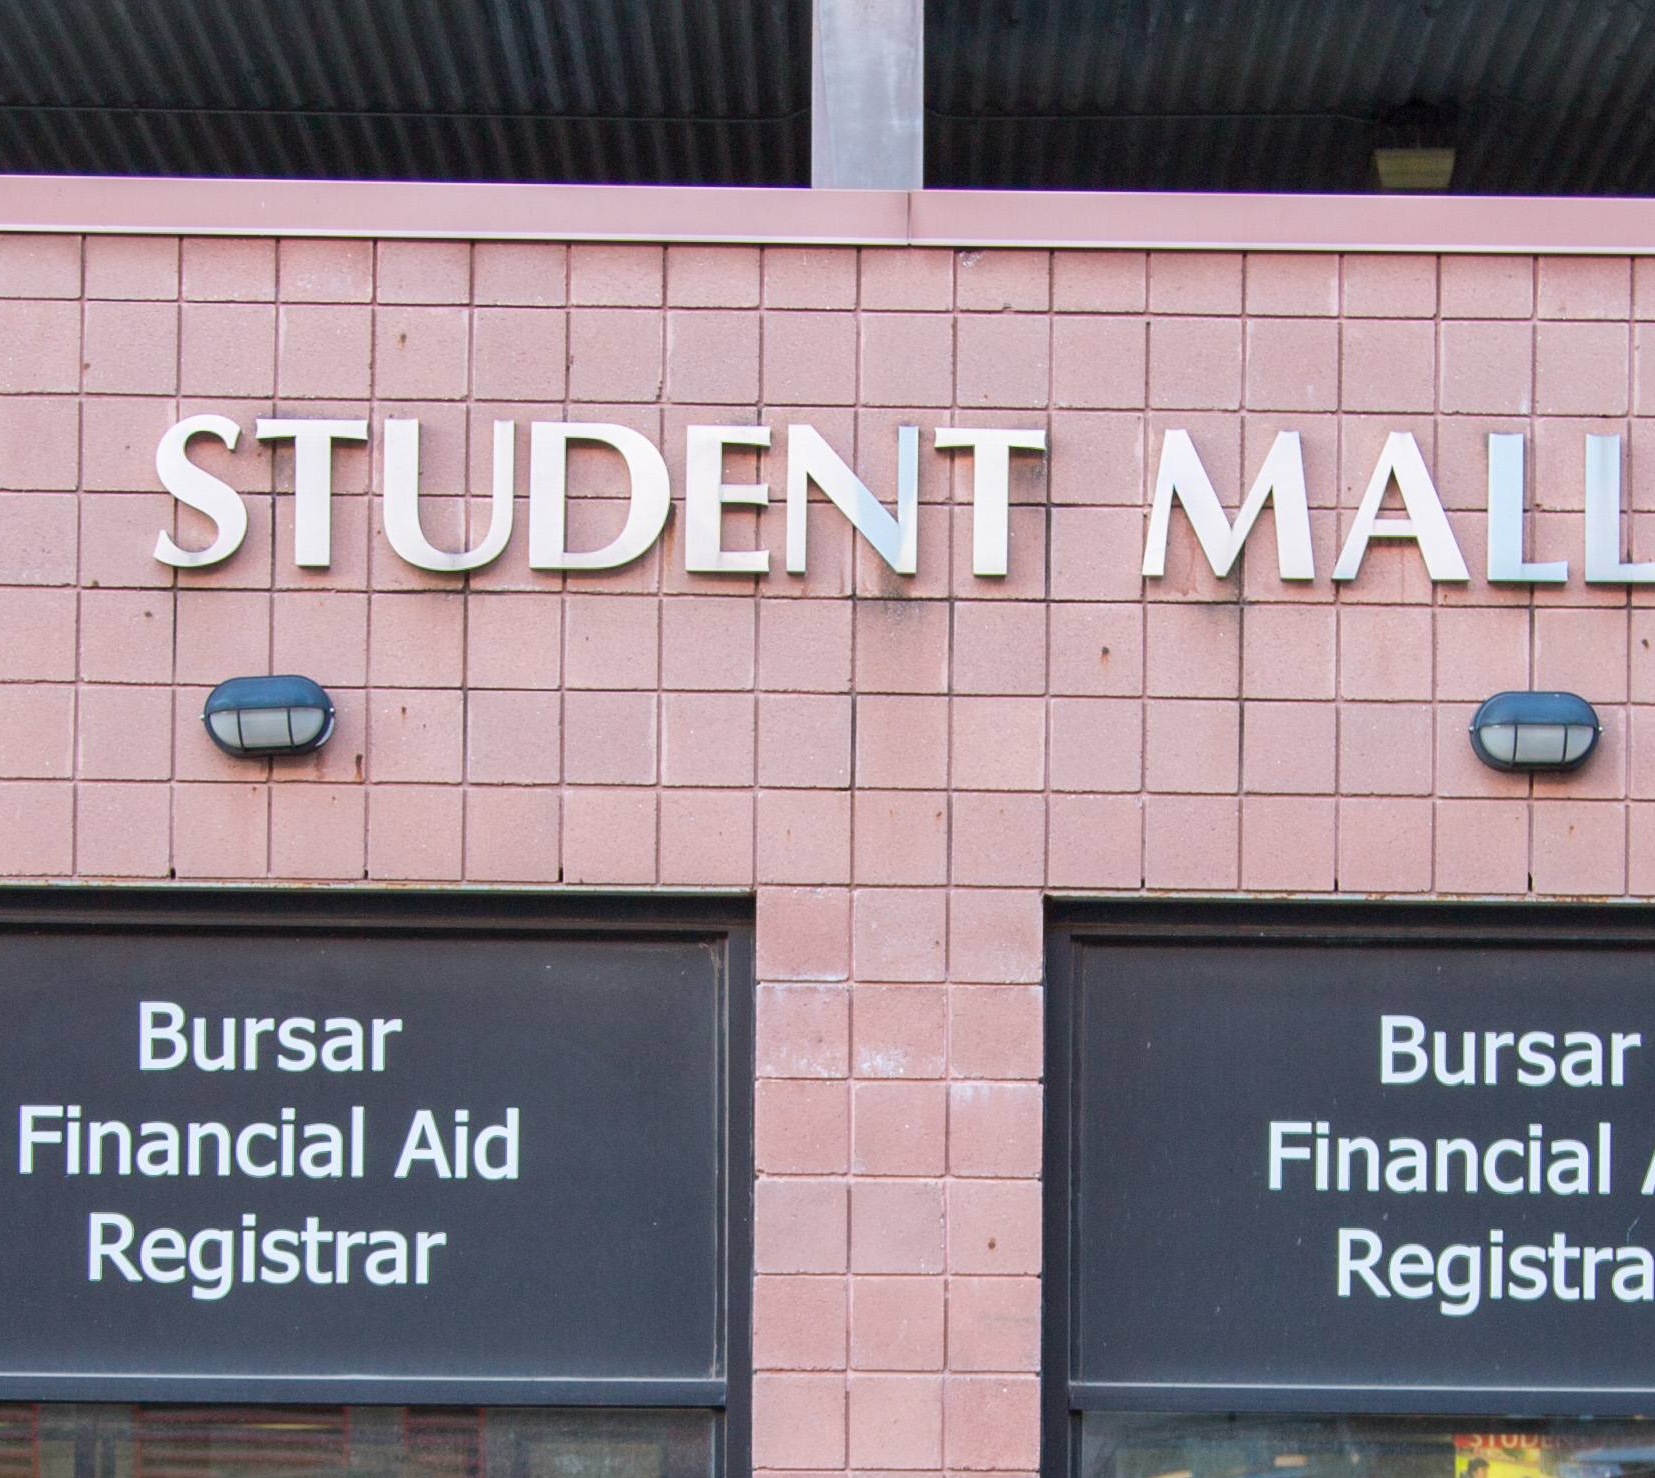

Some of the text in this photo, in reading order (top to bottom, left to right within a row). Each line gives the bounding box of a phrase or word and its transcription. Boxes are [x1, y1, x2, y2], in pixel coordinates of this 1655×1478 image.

[152, 412, 1048, 578] STUDENT
[140, 1001, 402, 1071] Bursar
[1381, 1015, 1641, 1085] Bursar
[20, 1105, 519, 1179] Financial Aid
[1269, 1121, 1611, 1194] Financial
[89, 1212, 446, 1299] Registrar
